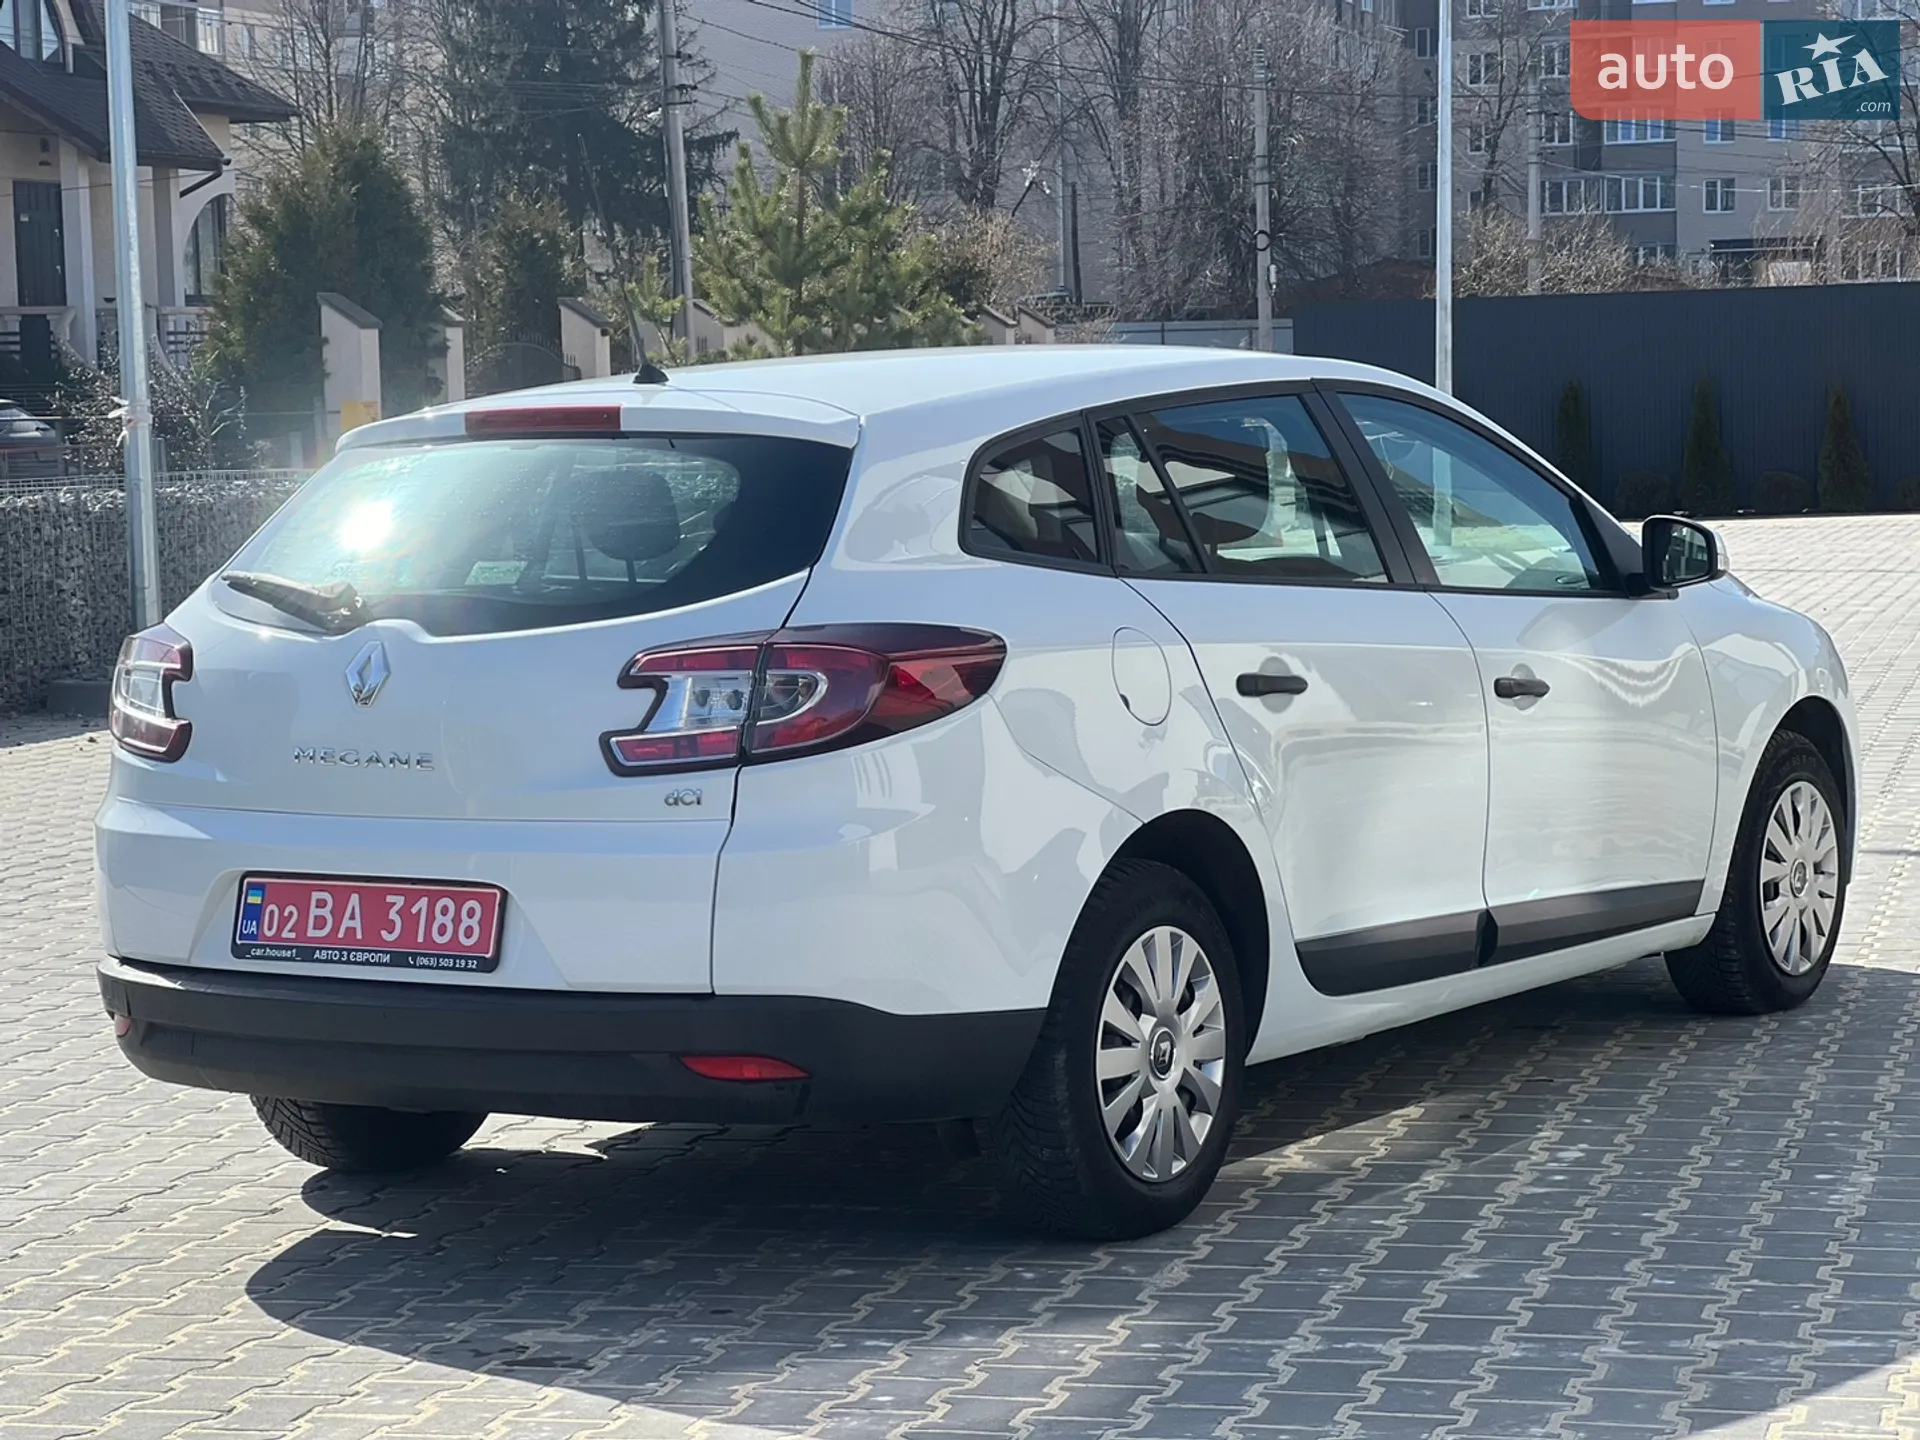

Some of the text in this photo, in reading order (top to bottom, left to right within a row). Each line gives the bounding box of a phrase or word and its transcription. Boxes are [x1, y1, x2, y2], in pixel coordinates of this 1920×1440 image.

[293, 746, 435, 771] MEGANE
[242, 890, 482, 947] UA 02 BA 3188
[313, 949, 339, 960] АВТО
[349, 951, 390, 963] ЄВРОПИ
[416, 956, 477, 969] (063) 503 19 32
